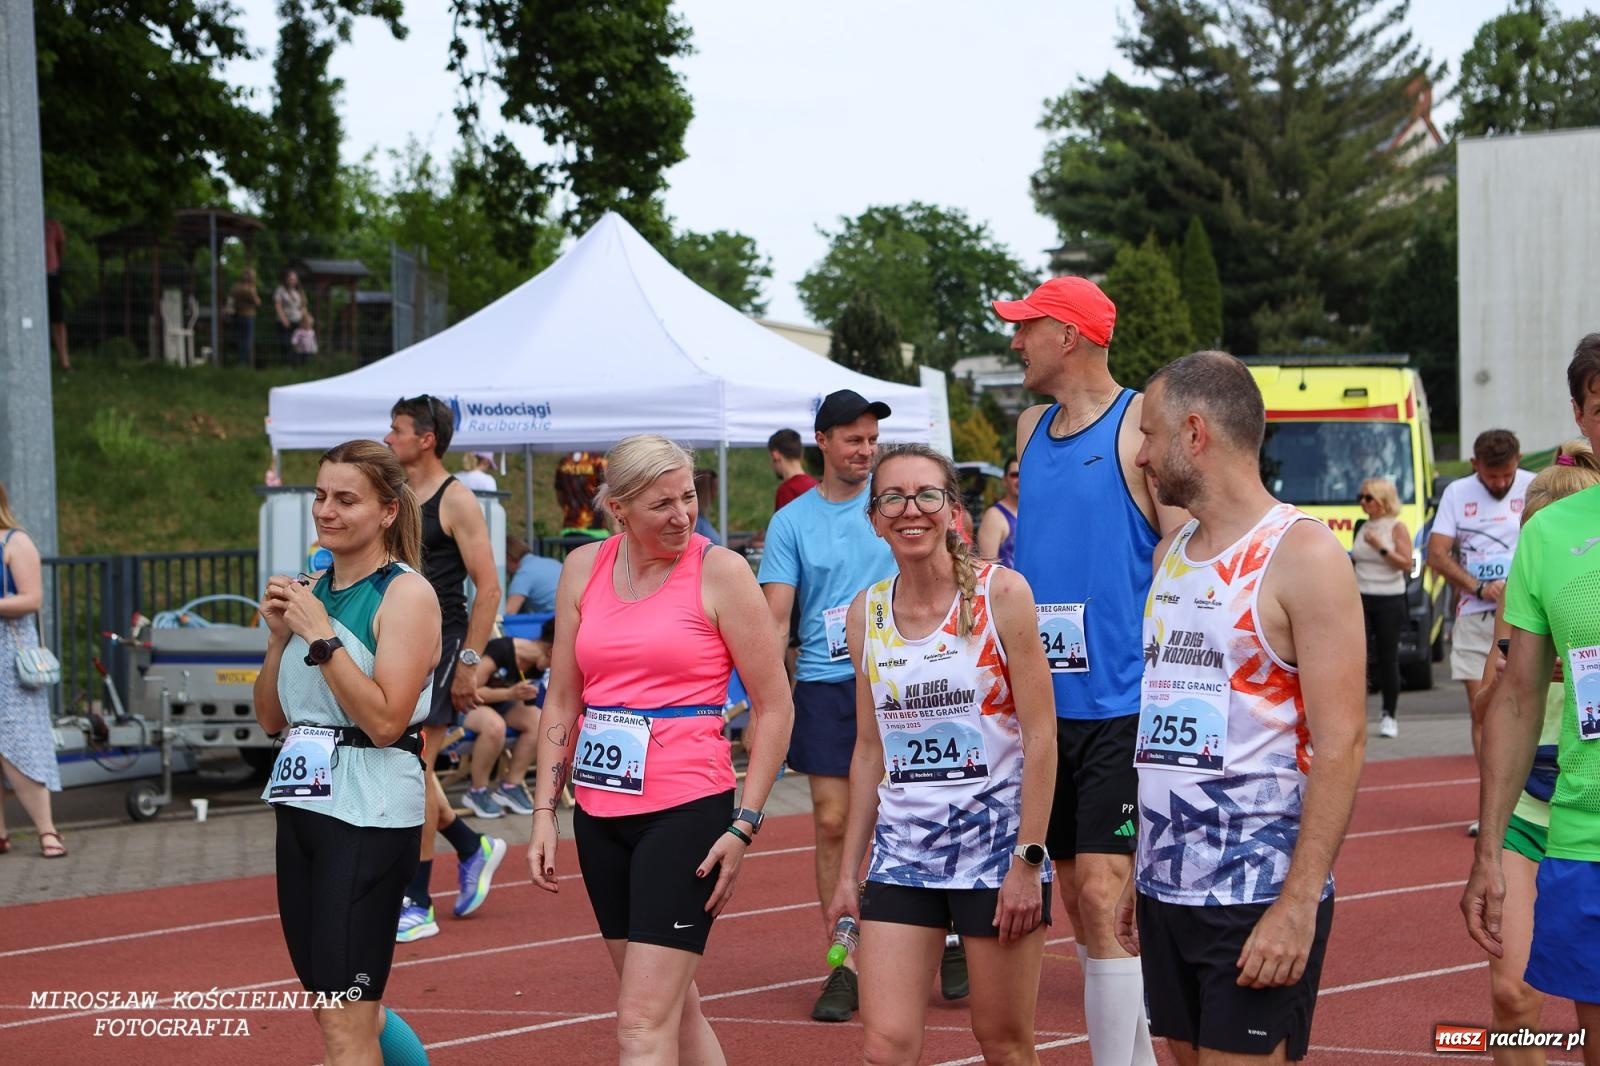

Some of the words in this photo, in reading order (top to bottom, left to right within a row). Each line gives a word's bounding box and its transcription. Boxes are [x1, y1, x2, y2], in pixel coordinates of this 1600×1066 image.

[467, 402, 552, 419] Wodociągi
[468, 420, 552, 432] Raciborskie
[1478, 565, 1504, 577] 250
[1168, 629, 1183, 646] XII
[1183, 632, 1205, 648] BIEG
[1162, 646, 1225, 669] KOZIOŁKÓW
[1578, 649, 1598, 659] XVII
[905, 684, 921, 699] XII
[922, 679, 949, 697] BIEG
[1172, 681, 1185, 689] BEZ
[1187, 682, 1222, 692] GRANIC
[904, 688, 976, 710] KOZIOŁKÓW
[598, 713, 612, 722] BEZ
[612, 715, 644, 726] GRANIC
[883, 712, 898, 720] XVII
[899, 711, 918, 719] BIEG
[920, 709, 935, 718] BEZ
[936, 705, 970, 717] GRANIC
[303, 728, 334, 737] GRANIC
[1150, 715, 1197, 746] 255
[582, 740, 622, 770] 229
[907, 737, 961, 765] 254
[276, 755, 307, 782] 188
[1122, 803, 1134, 814] PP
